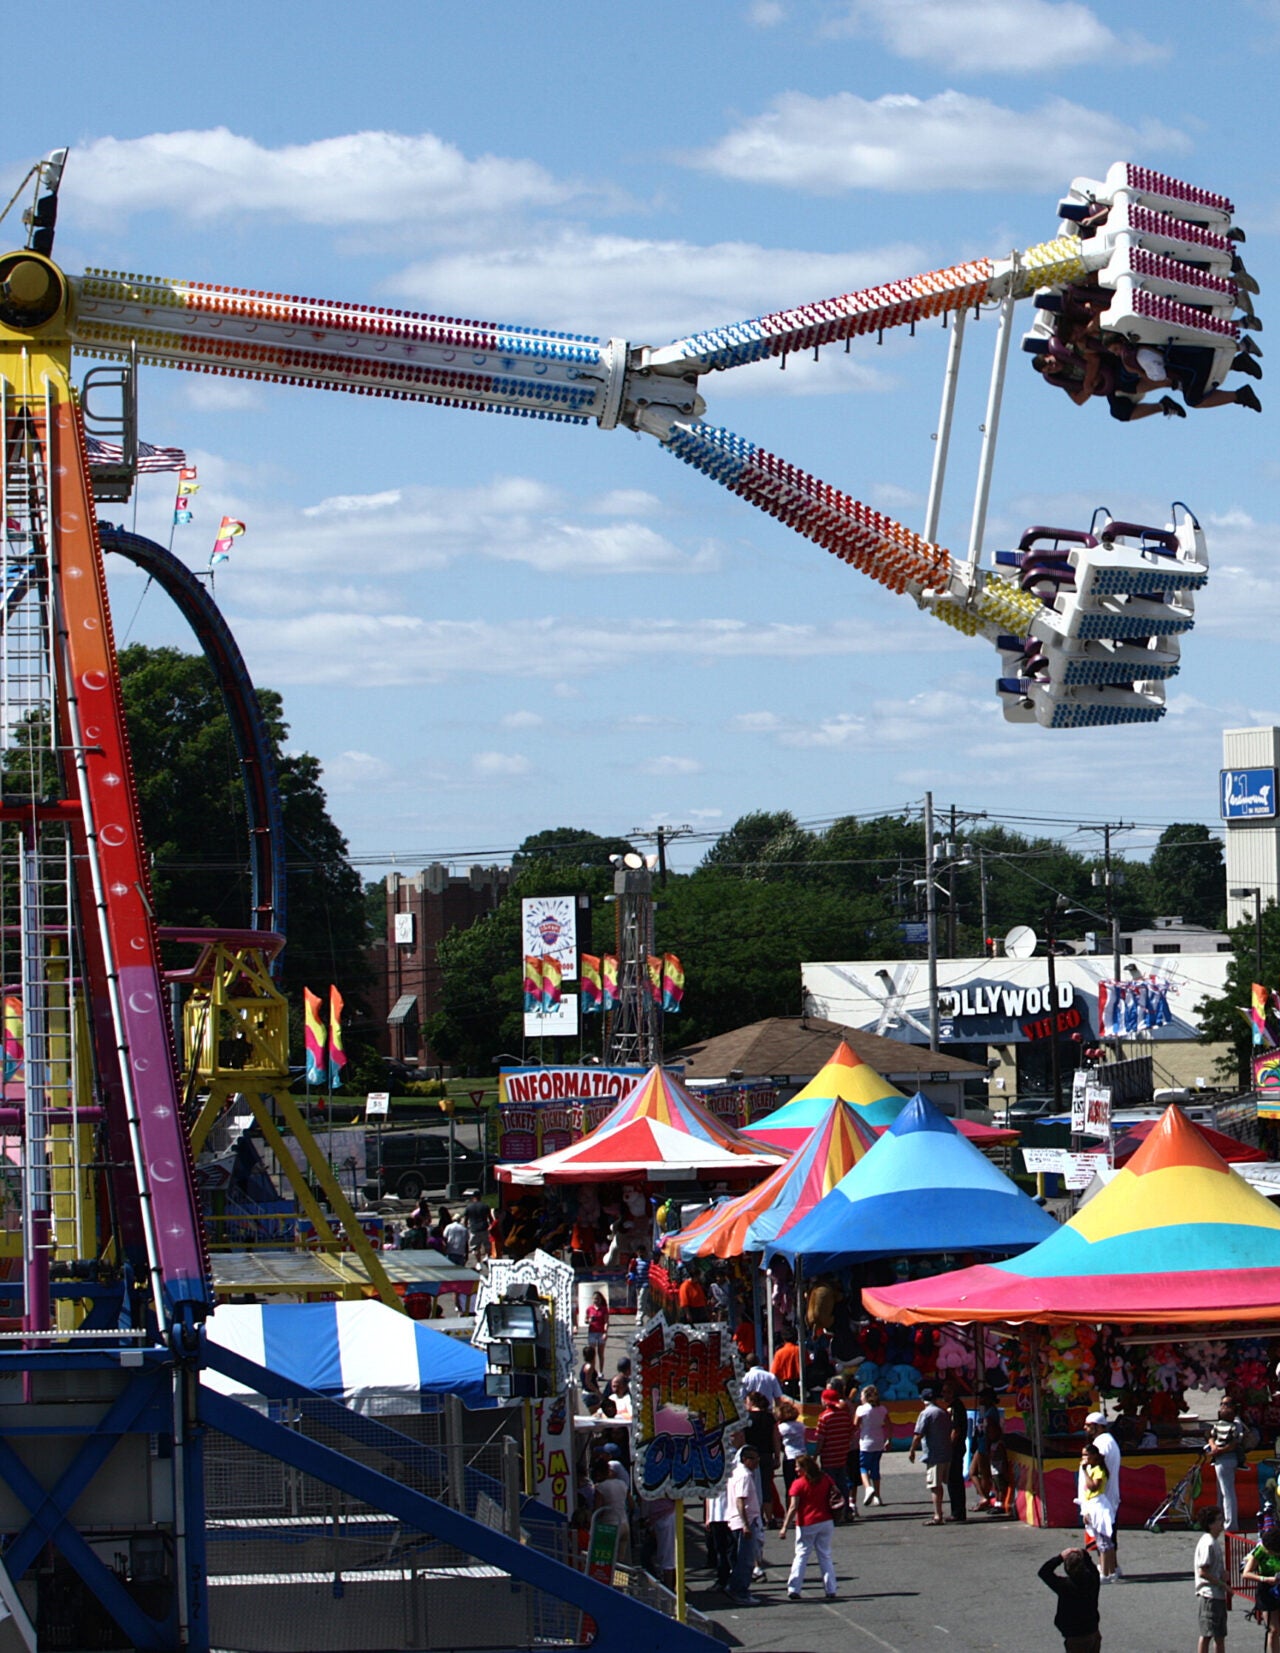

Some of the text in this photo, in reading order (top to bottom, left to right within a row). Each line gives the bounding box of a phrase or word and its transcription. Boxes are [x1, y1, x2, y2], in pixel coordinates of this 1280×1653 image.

[945, 981, 1074, 1017] OLLYWOOD
[508, 1072, 638, 1103] INFORMATION
[501, 1113, 536, 1133] TICKETS
[541, 1110, 570, 1133] TICKETS
